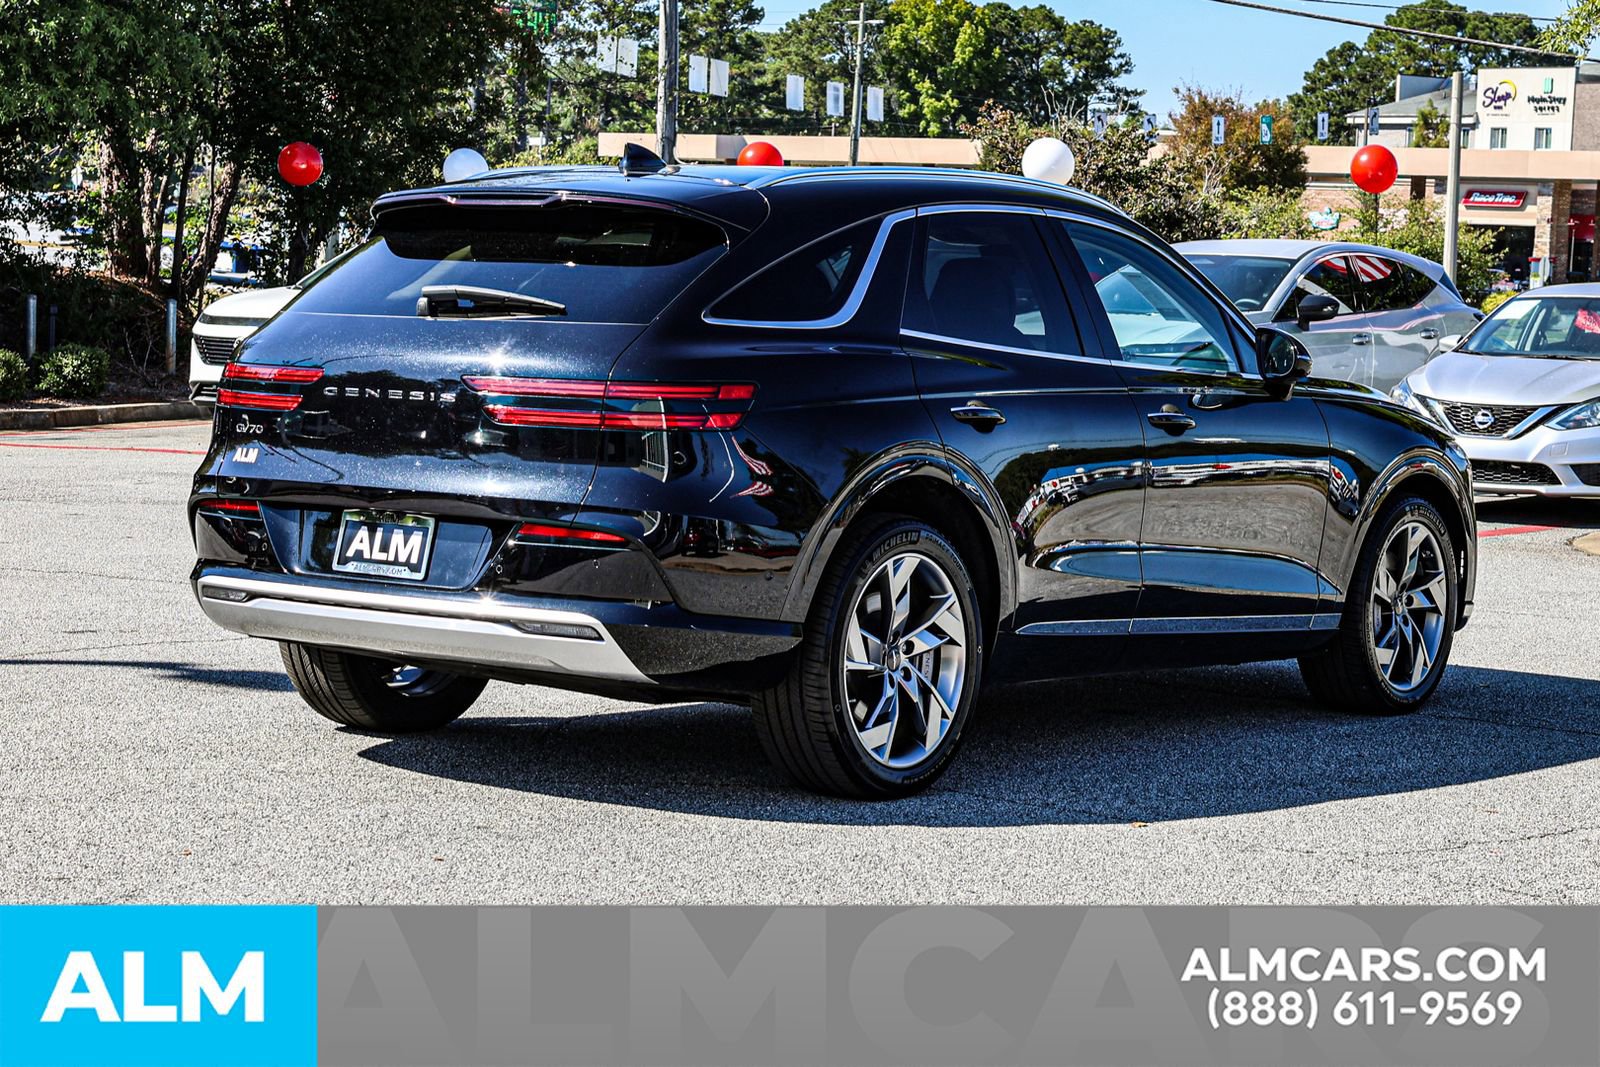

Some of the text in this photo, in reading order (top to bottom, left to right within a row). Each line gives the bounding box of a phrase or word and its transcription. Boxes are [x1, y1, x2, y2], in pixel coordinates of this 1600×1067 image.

[1482, 86, 1513, 108] Sleep
[324, 386, 456, 402] GENESIS
[232, 448, 259, 464] ALM
[345, 525, 424, 564] ALM
[872, 531, 919, 562] MICHELIN
